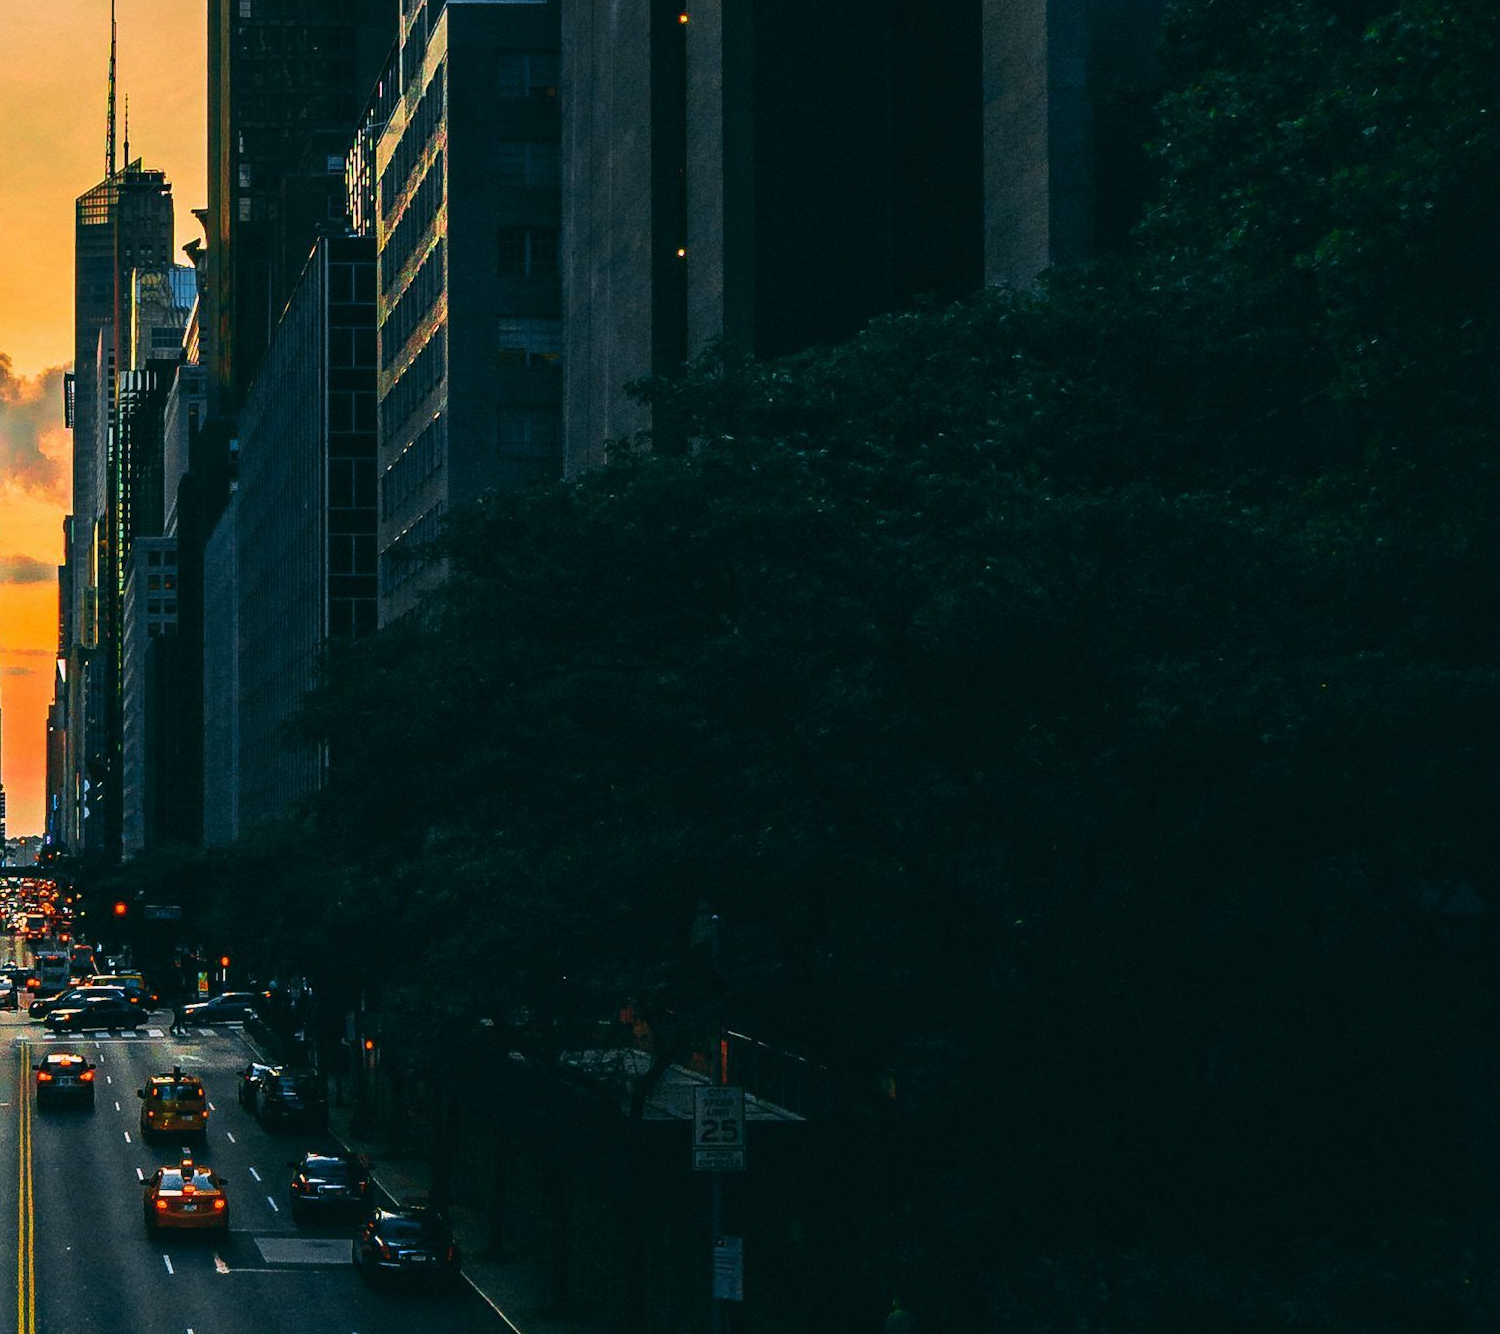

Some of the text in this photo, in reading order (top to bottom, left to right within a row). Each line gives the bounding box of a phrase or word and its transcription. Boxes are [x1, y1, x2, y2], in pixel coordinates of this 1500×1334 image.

[708, 1089, 729, 1097] CITY
[703, 1098, 733, 1107] SPEED
[706, 1108, 730, 1116] LIMIT
[701, 1120, 739, 1142] 25
